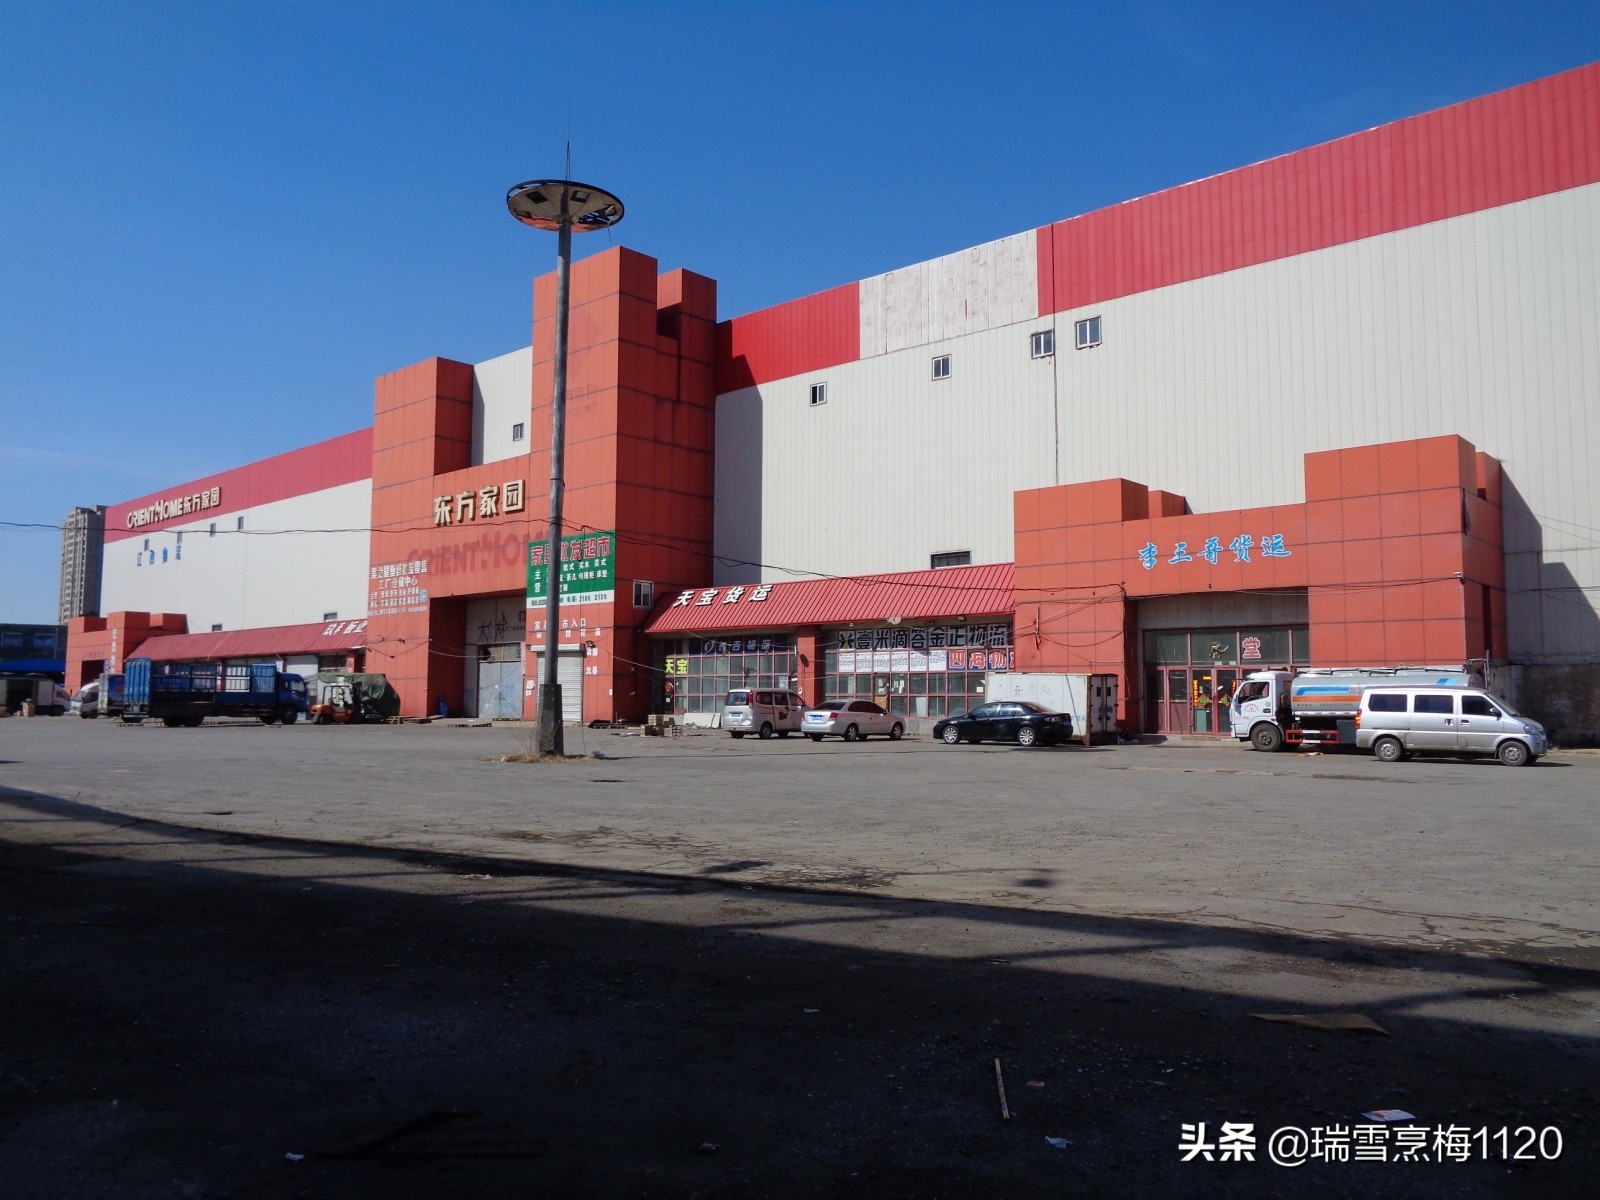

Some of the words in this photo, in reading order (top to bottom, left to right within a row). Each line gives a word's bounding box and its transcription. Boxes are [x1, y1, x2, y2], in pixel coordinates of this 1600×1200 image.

[184, 487, 220, 515] 东方家园
[433, 479, 524, 526] 东方家园
[1138, 534, 1292, 570] 李三哥货运
[672, 584, 773, 607] 天宝货运
